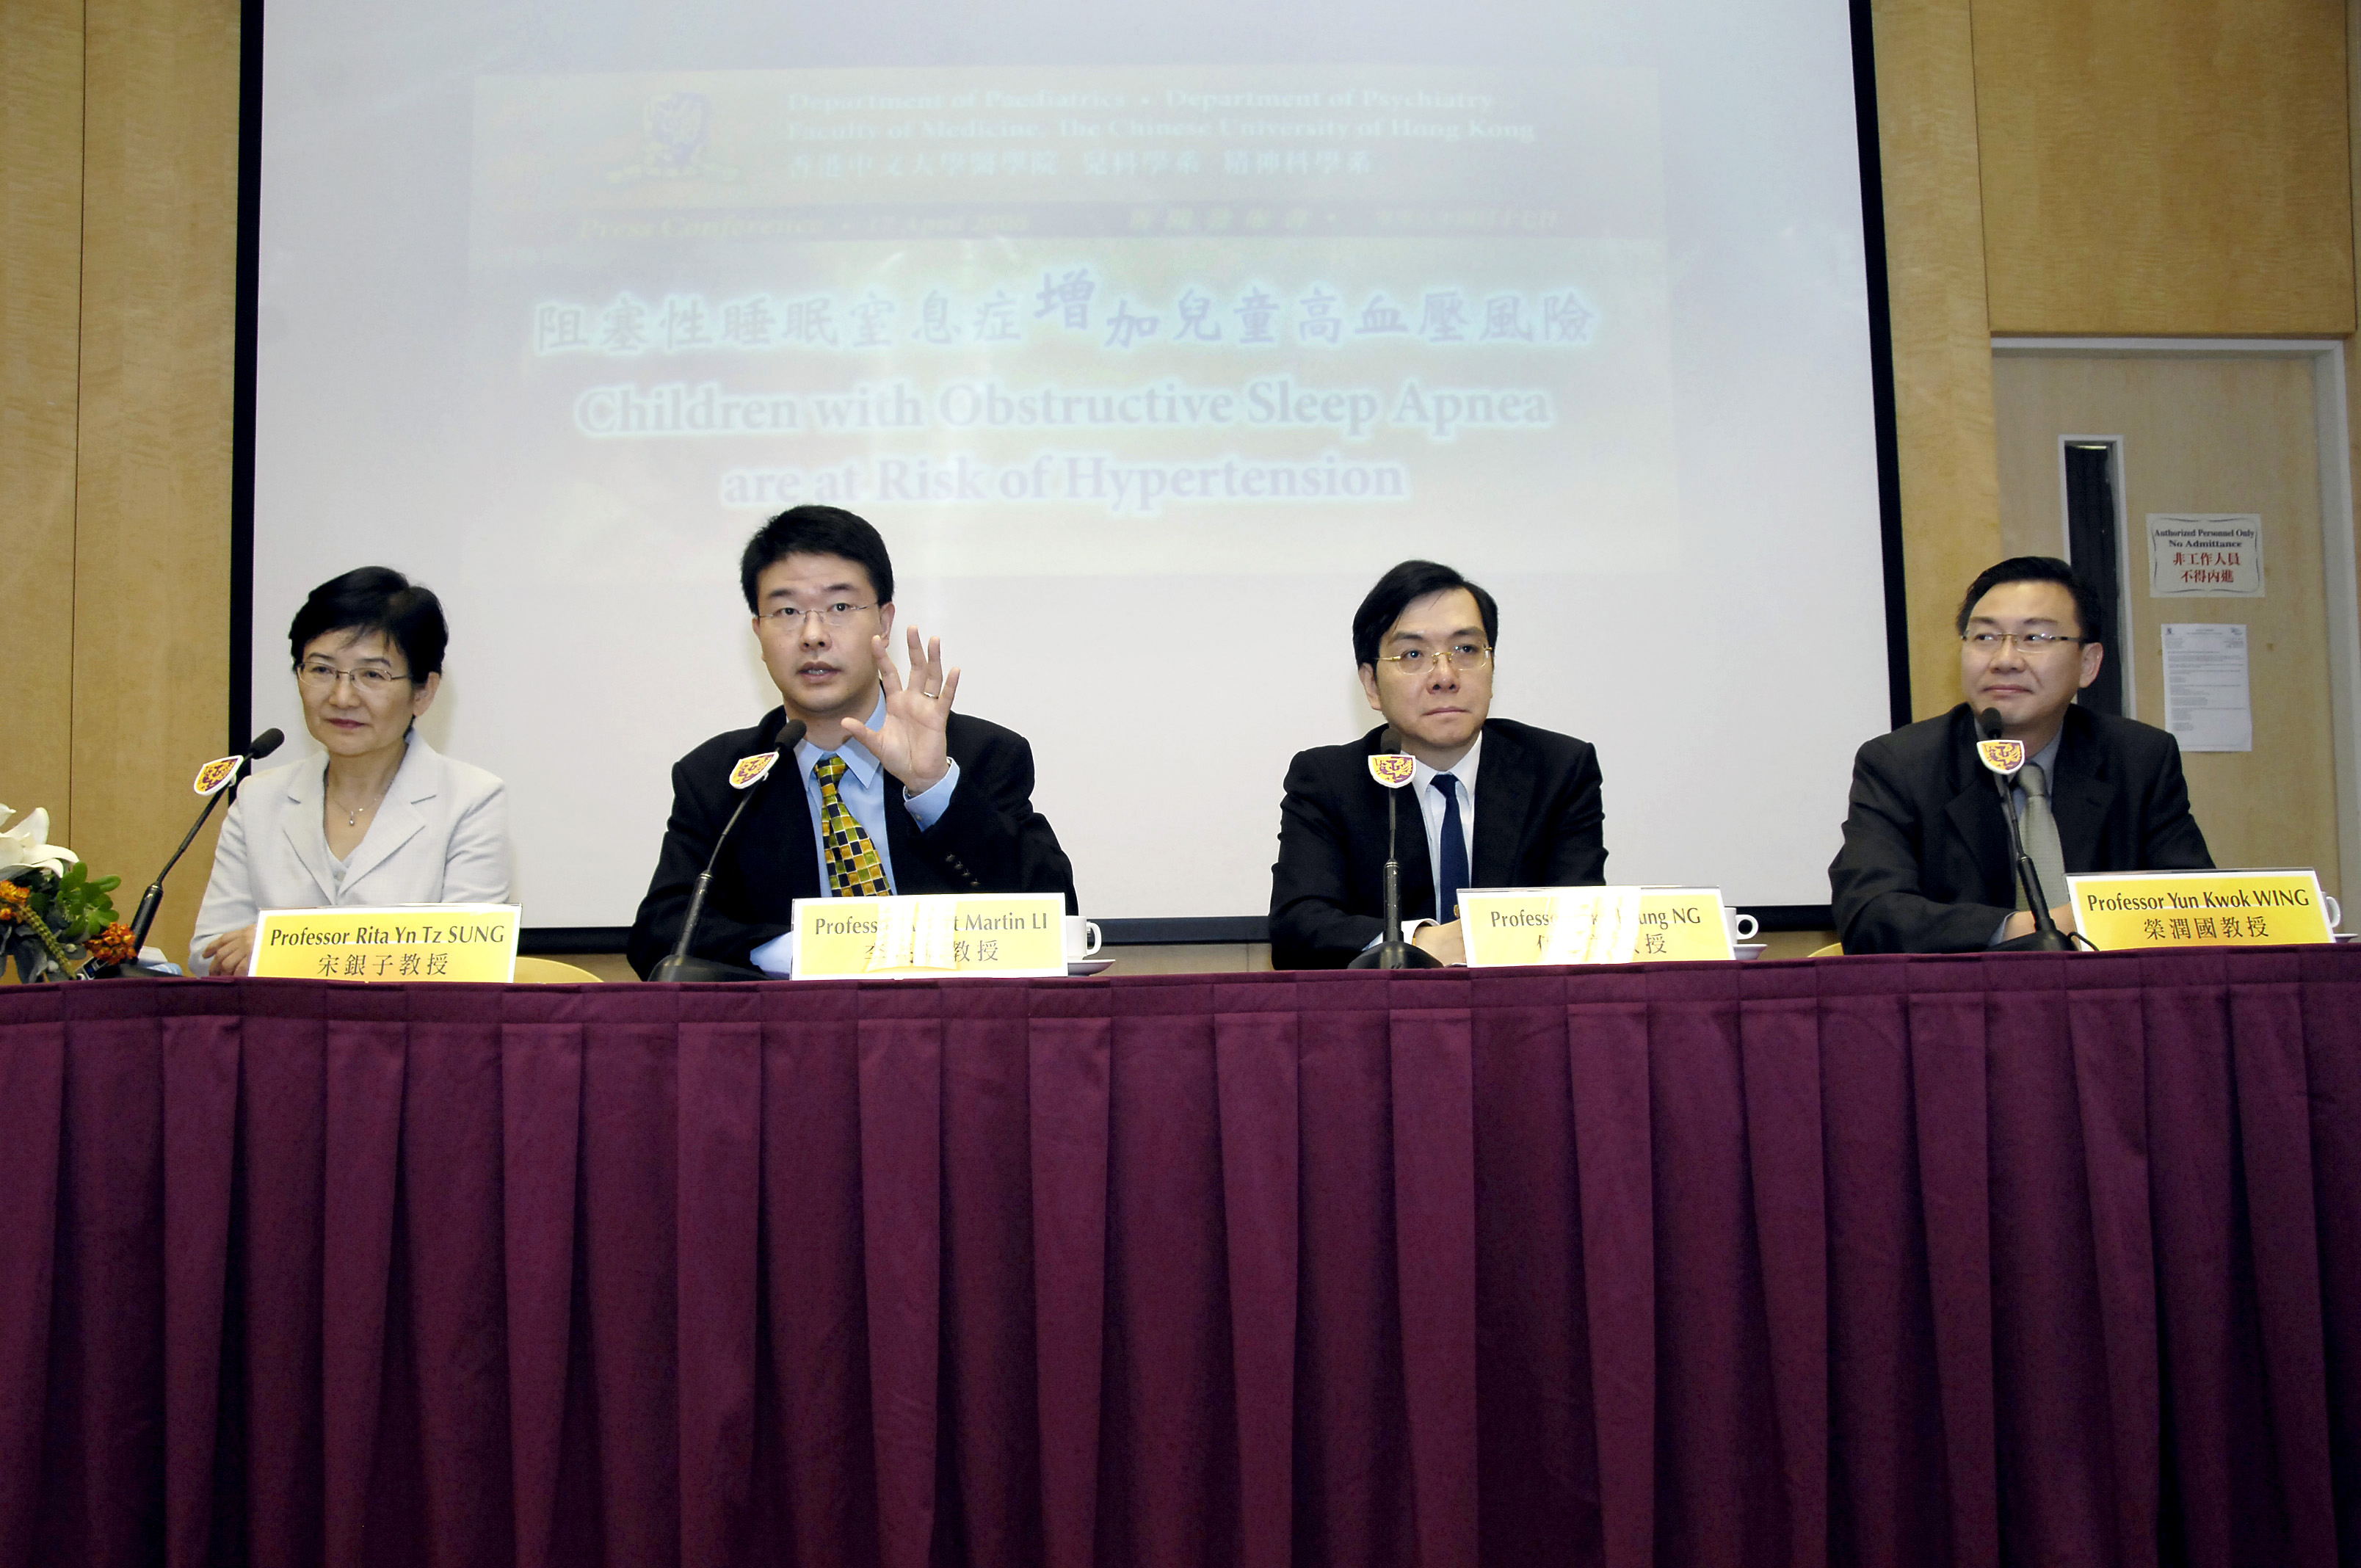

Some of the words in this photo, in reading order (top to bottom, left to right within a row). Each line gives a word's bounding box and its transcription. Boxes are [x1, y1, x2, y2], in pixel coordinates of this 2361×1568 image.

[788, 92, 943, 115] Department
[951, 90, 977, 109] of
[1166, 90, 1323, 115] Department
[1330, 87, 1357, 108] of
[1363, 89, 1495, 114] Psychiatry
[788, 122, 881, 145] Faculty
[888, 120, 915, 139] of
[1108, 118, 1212, 139] Chinese
[1219, 118, 1350, 142] University
[1357, 117, 1386, 138] of
[1390, 118, 1461, 142] Hong
[1468, 119, 1537, 144] Kong
[579, 385, 800, 432] Children
[812, 384, 925, 428] with
[940, 381, 1234, 428] Obstructive
[1247, 380, 1378, 435] Sleep
[1393, 382, 1551, 436] Apnea
[723, 472, 801, 505] are
[813, 463, 858, 504] at
[875, 457, 987, 501] Risk
[997, 454, 1053, 499] of
[1065, 452, 1404, 512] Hypertension
[2154, 529, 2197, 537] Authorized
[2198, 529, 2235, 537] Personnel
[2236, 529, 2255, 539] Only
[2169, 540, 2183, 548] No
[2185, 540, 2243, 548] Admittance
[2172, 552, 2241, 566] 非工作人員
[2087, 892, 2164, 912] Professor
[2166, 891, 2199, 910] Yun
[2203, 890, 2251, 909] Kwok
[2253, 888, 2310, 907] WING
[815, 915, 880, 935] Profess
[965, 912, 1026, 932] Martin
[1032, 912, 1048, 930] LI
[1490, 908, 1558, 928] Profess
[1672, 907, 1702, 925] NG
[2143, 915, 2270, 940] 榮潤國教授
[270, 926, 351, 947] Professor
[356, 925, 389, 945] Rita
[395, 926, 417, 945] Yn
[422, 926, 442, 944] Tz
[448, 924, 505, 943] SUNG
[316, 952, 450, 977] 宋銀子教授
